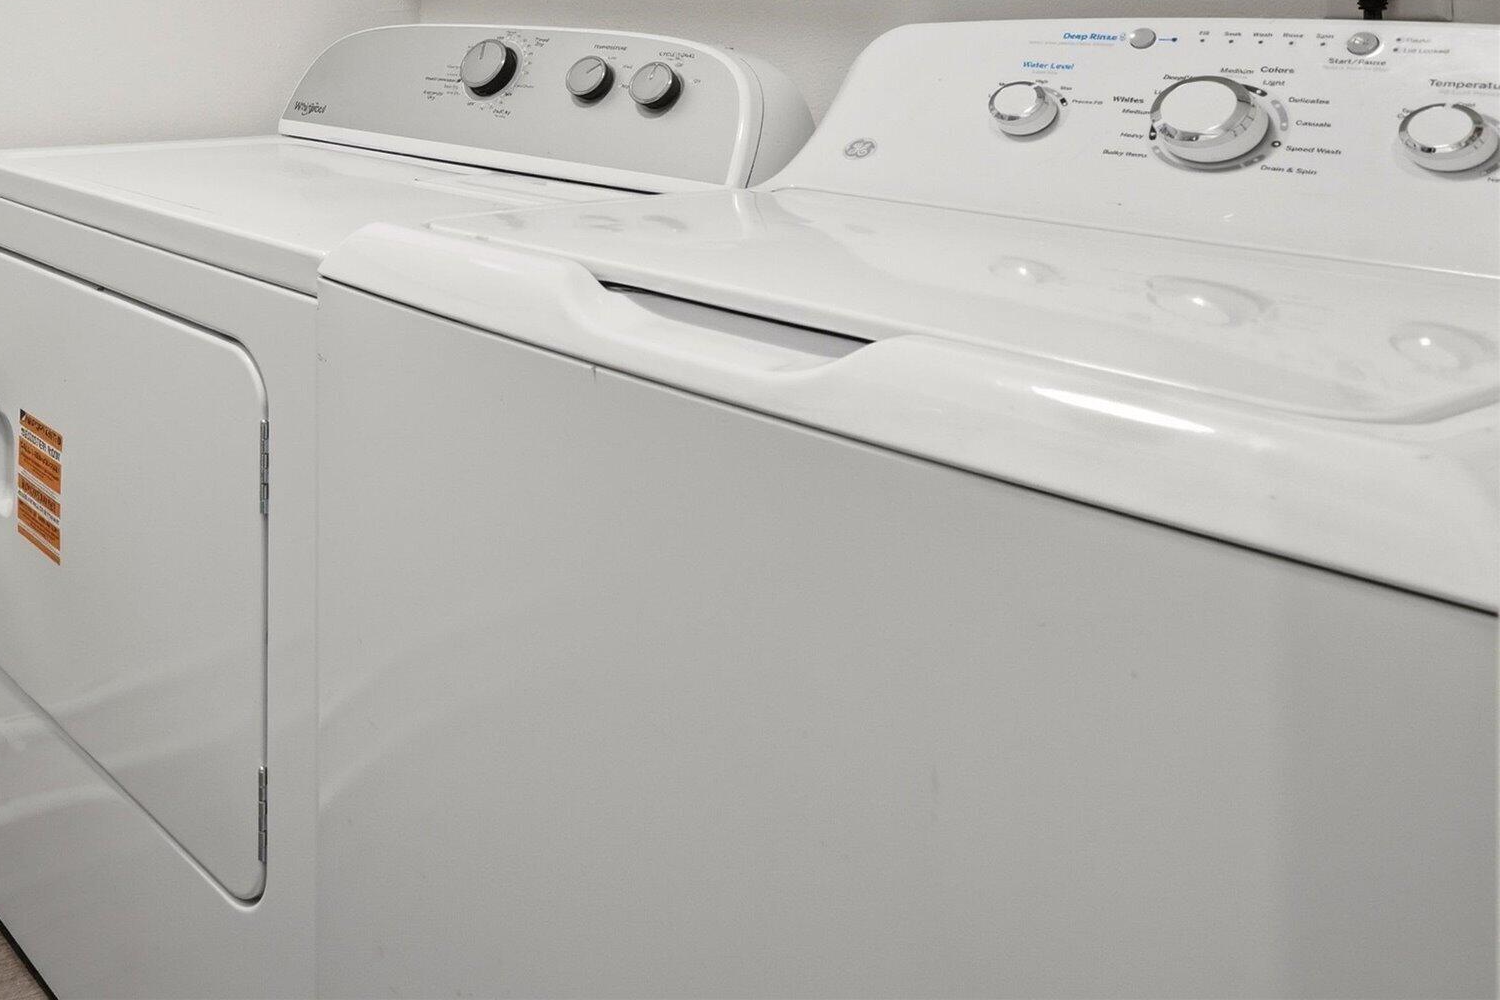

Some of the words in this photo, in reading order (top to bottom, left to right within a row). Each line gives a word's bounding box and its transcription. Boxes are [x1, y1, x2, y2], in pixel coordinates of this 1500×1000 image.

[1063, 32, 1088, 41] Deep
[1089, 32, 1118, 40] Rinse
[1023, 61, 1048, 70] Water
[1050, 62, 1075, 70] Level
[1220, 67, 1254, 75] Medium
[1260, 66, 1295, 74] Colors
[1429, 78, 1500, 90] Temperatu
[1112, 96, 1144, 104] Whites
[1288, 96, 1330, 104] Delicates
[294, 101, 327, 116] Whirlpool
[1286, 145, 1315, 154] Speed
[1260, 164, 1284, 172] Drain
